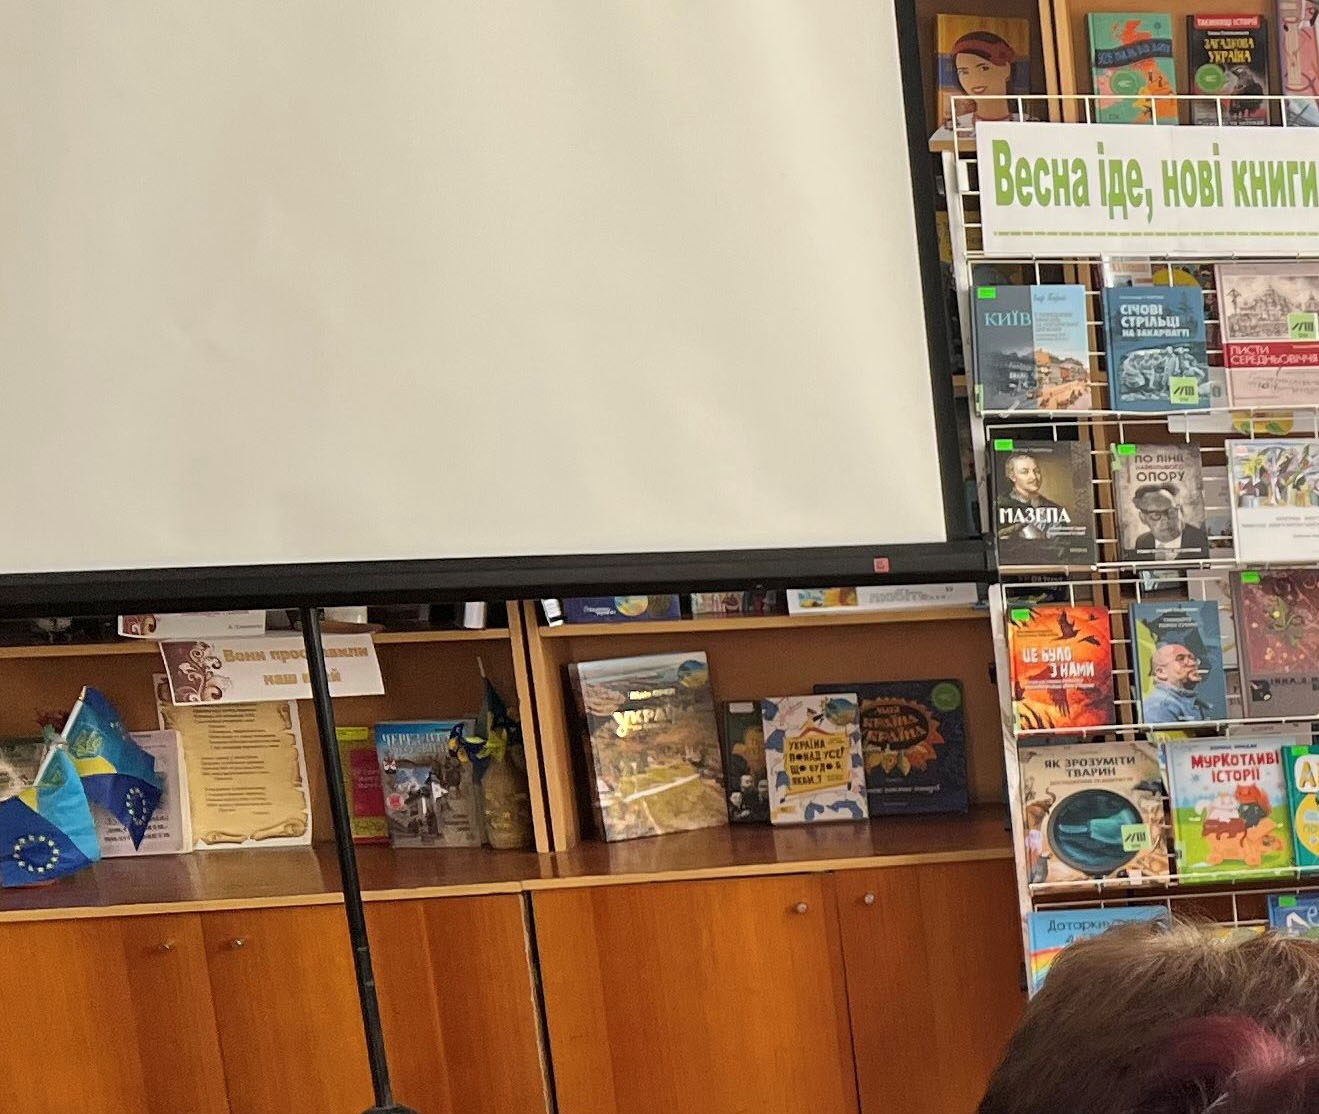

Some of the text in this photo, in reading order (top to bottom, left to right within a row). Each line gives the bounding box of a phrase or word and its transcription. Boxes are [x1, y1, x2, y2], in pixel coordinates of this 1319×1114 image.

[1208, 49, 1252, 63] УКРАЇНА
[992, 138, 1090, 208] Весна
[1097, 142, 1154, 224] іде,
[1163, 142, 1222, 208] нові
[1231, 155, 1317, 209] книги
[1119, 304, 1164, 316] СІЧОВІ
[984, 311, 1032, 327] КИЇВ
[1120, 316, 1181, 329] СТРІЛЬЦІ
[1122, 329, 1135, 337] НА
[1135, 454, 1153, 464] ПО
[1136, 471, 1185, 482] ОПОРУ
[1000, 507, 1071, 524] МАЗЕПА
[223, 649, 266, 662] Вони
[1023, 645, 1072, 663] ЦЕ БУЛО
[1049, 661, 1095, 678] З НАМИ
[263, 673, 297, 685] наш
[1044, 756, 1136, 769] ЯК ЗРОЗУМІТИ
[1065, 767, 1116, 778] ТВАРИН
[1212, 769, 1260, 783] ІСТОРІЇ
